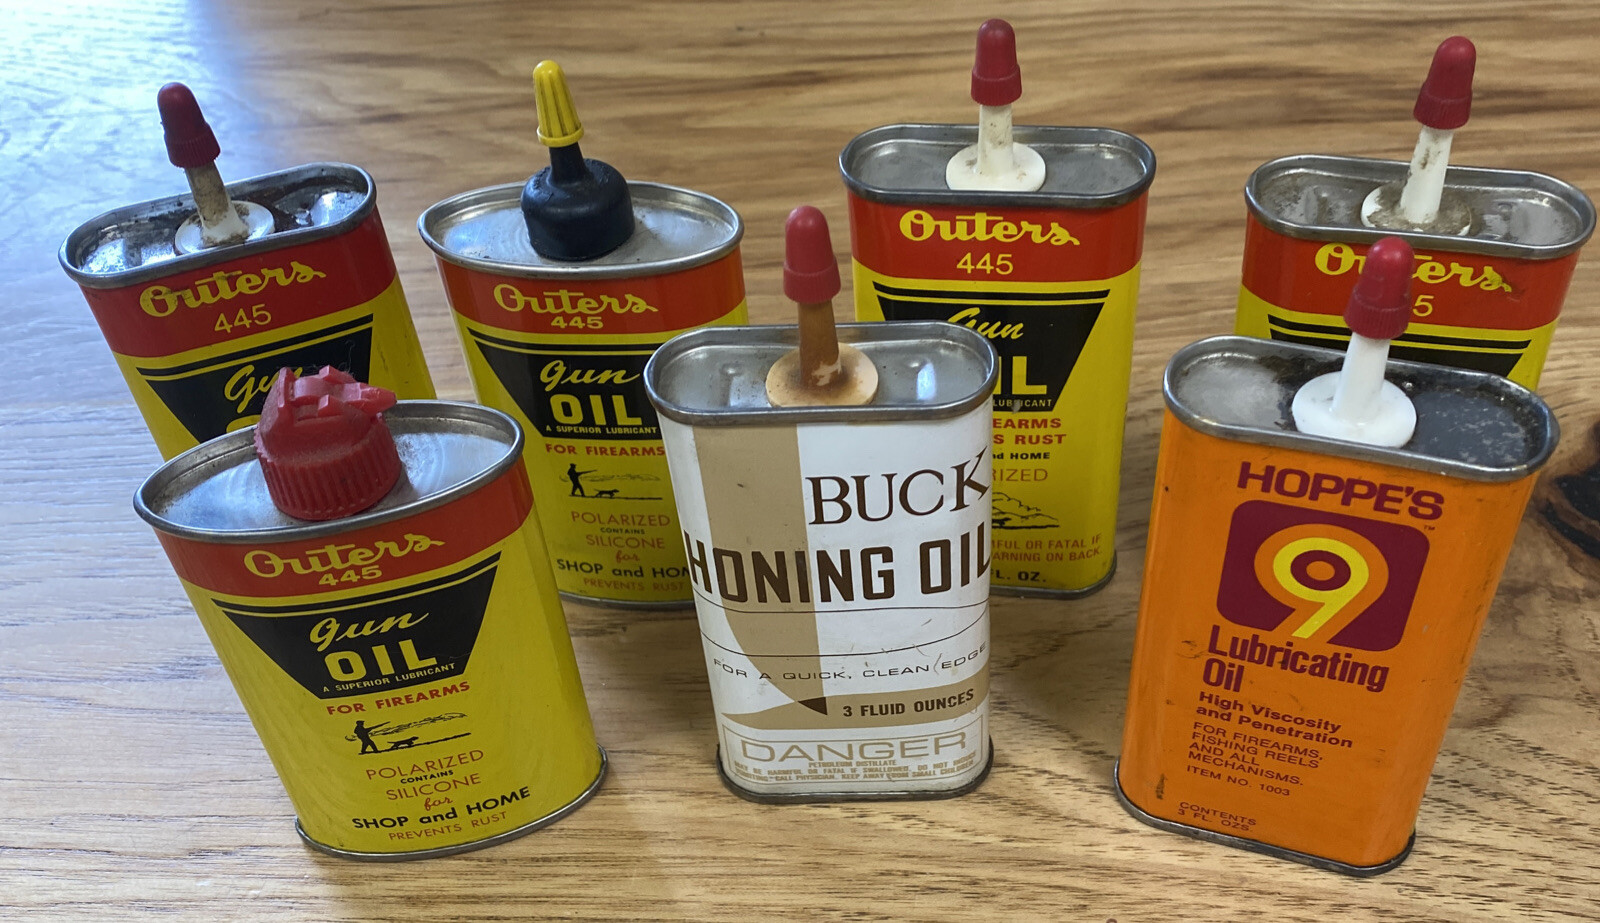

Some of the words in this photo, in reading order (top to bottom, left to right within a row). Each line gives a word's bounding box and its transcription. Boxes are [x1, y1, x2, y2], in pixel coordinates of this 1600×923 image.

[900, 210, 1080, 246] Outers
[956, 253, 1013, 276] 445
[1315, 242, 1512, 292] Oers
[140, 261, 326, 316] Outers
[494, 284, 658, 314] Outers
[214, 304, 272, 334] 445
[551, 317, 603, 329] 445
[224, 365, 303, 414] Gu
[540, 360, 640, 392] Gun
[550, 394, 642, 426] OIL
[993, 418, 1062, 429] EARMS
[556, 426, 602, 434] SUPERIOR
[1015, 434, 1066, 444] RUST
[545, 444, 577, 454] FOR
[586, 445, 666, 456] FIREARMS
[805, 446, 990, 524] BUCK
[1238, 462, 1444, 520] HOPPE'S
[571, 511, 670, 526] POLARIZED
[244, 533, 445, 578] Outers
[586, 535, 666, 549] SILICONE
[615, 551, 640, 563] for
[993, 552, 1040, 562] ARNING
[1046, 552, 1063, 562] ON
[1026, 540, 1042, 550] OR
[1048, 539, 1086, 549] FATAL
[1092, 534, 1100, 544] IF
[318, 566, 383, 586] 445
[557, 558, 604, 574] SHOP
[612, 566, 644, 578] and
[683, 529, 895, 604] HONING
[919, 521, 992, 595] OIL
[1018, 571, 1046, 582] OZ.
[583, 578, 644, 592] PREVENTS
[653, 580, 686, 590] RUST
[1273, 537, 1369, 638] 9
[309, 612, 429, 652] Gun
[324, 639, 438, 682] OIL
[714, 658, 748, 679] FOR
[783, 671, 852, 680] QUICK,
[863, 664, 930, 678] CLEAN
[942, 641, 986, 669] EDGE
[1208, 624, 1390, 692] Lubricating
[336, 678, 390, 692] SUPERIOR
[395, 663, 456, 682] LUBRICANT
[1203, 658, 1245, 692] Oil
[326, 703, 366, 716] FOR
[376, 681, 470, 710] FIREARMS
[843, 705, 853, 717] 3
[860, 703, 905, 716] FLUID
[914, 688, 974, 712] OUNCES
[1200, 692, 1244, 712] High
[1252, 704, 1342, 734] Viscosity
[1194, 722, 1226, 737] FOR
[1233, 732, 1324, 760] FIREARMS,
[1196, 706, 1232, 722] and
[1238, 715, 1353, 748] Penetration
[740, 731, 966, 762] DANGER
[1190, 742, 1224, 756] AND
[1230, 752, 1260, 766] ALL
[1192, 732, 1258, 755] FISHING
[1265, 750, 1319, 768] REELS
[366, 750, 484, 780] POLARIZED
[400, 770, 454, 784] CONTAINS
[1188, 751, 1303, 785] MECHANISMS.
[386, 773, 481, 800] SILICONE
[1187, 765, 1221, 780] ITEM
[1227, 776, 1252, 788] NO.
[1260, 784, 1290, 796] 1003
[352, 816, 408, 829] SHOP
[420, 808, 458, 824] and
[466, 786, 530, 815] HOME
[424, 797, 453, 811] for
[1180, 802, 1256, 826] CONTENTS
[389, 824, 462, 840] PREVENTS
[471, 811, 506, 828] RUST
